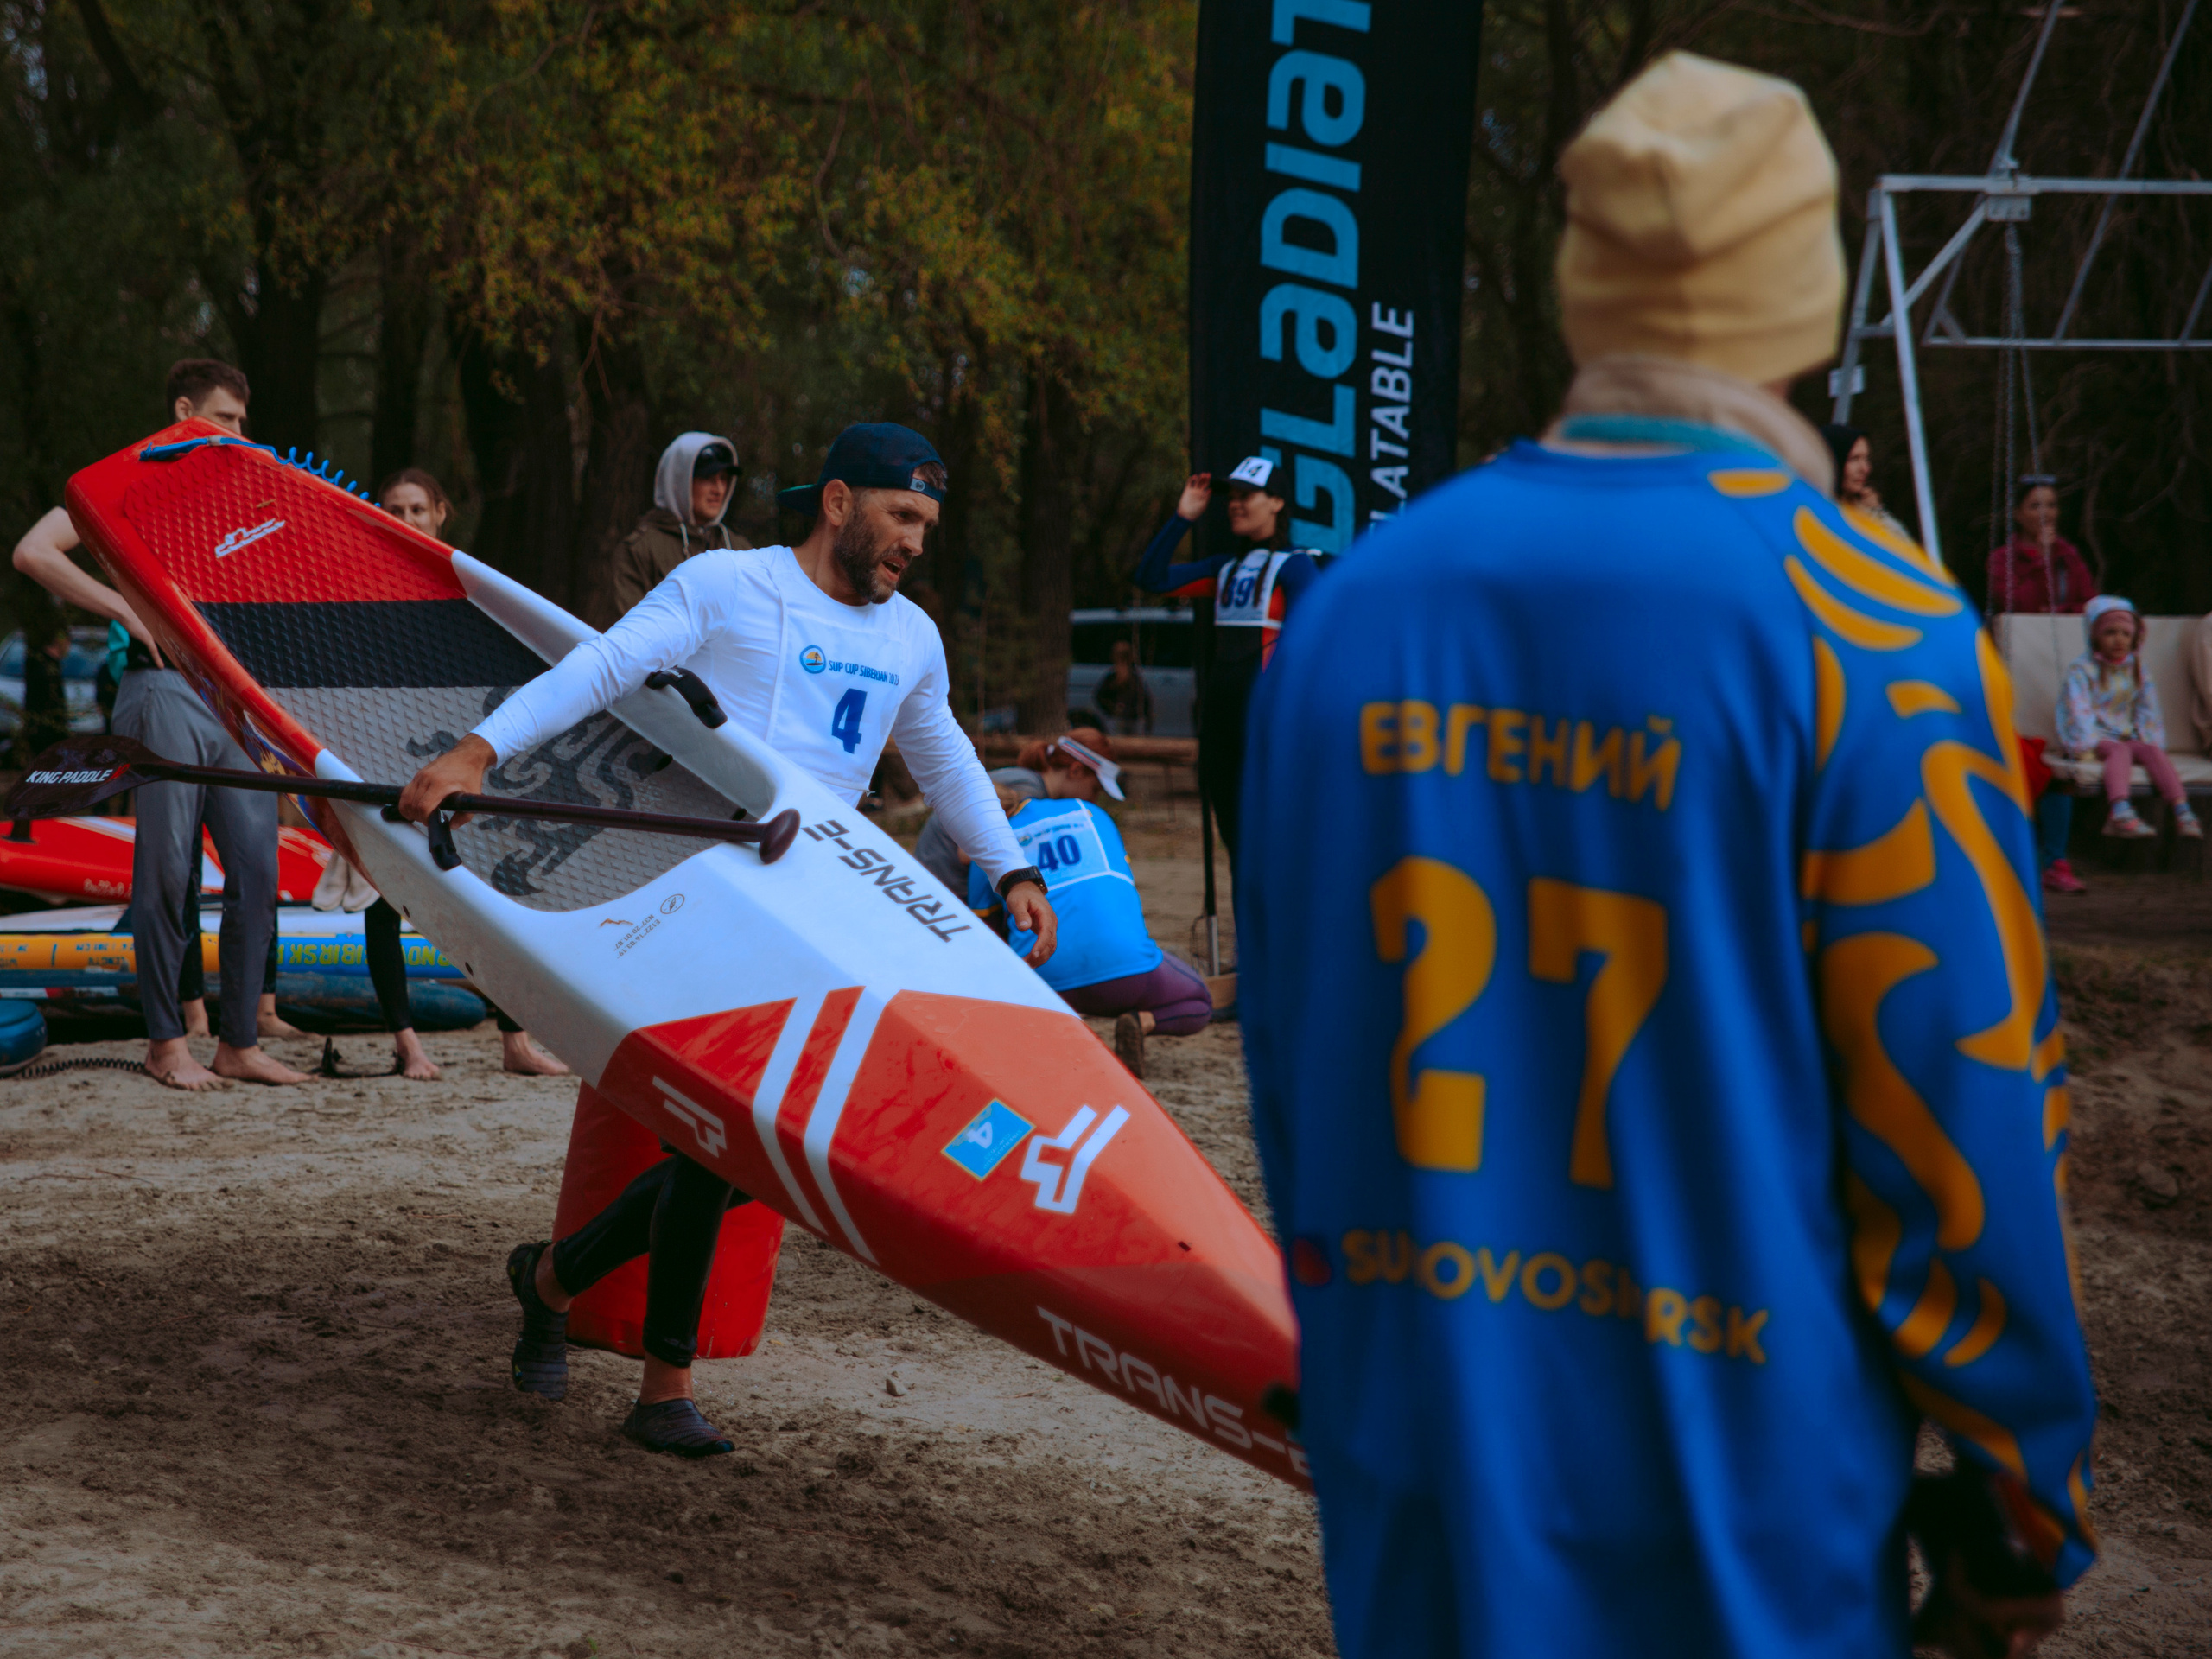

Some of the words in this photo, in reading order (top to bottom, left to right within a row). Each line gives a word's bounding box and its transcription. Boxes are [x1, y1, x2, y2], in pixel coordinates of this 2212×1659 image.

[1369, 301, 1414, 529] LATABLE
[829, 660, 843, 672] SUP
[845, 663, 859, 675] CUP
[859, 665, 887, 683] SIBERIAN
[831, 688, 868, 754] 4
[26, 770, 63, 784] KING
[58, 769, 113, 784] PADDLE
[1359, 699, 1681, 811] ЕВГЕНИЙ
[800, 819, 972, 943] TRANS-E
[1037, 835, 1081, 872] 40
[1370, 855, 1668, 1190] 27
[966, 1121, 993, 1149] 4
